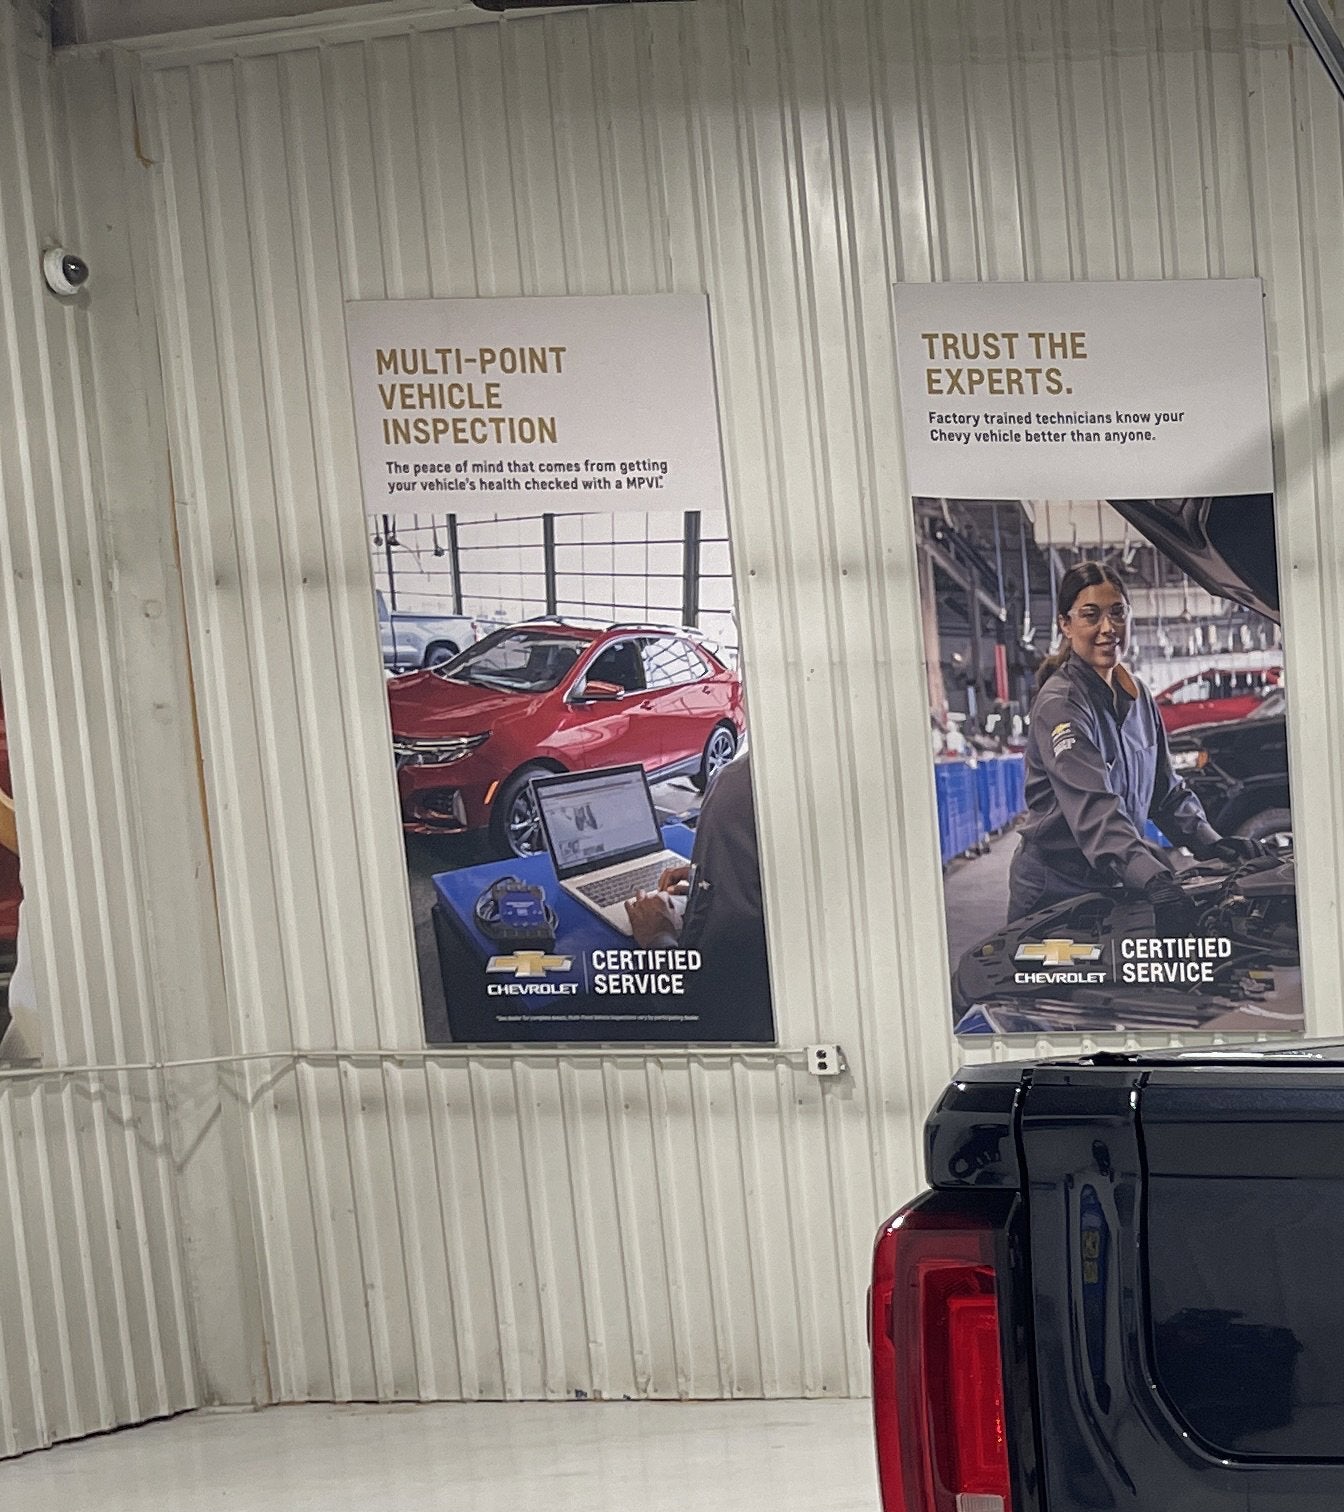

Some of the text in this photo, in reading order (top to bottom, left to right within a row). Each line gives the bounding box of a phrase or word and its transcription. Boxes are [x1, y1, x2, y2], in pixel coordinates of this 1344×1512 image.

[921, 331, 1088, 360] TRUST THE
[376, 346, 566, 375] MULTI-POINT
[926, 367, 1073, 395] EXPERTS.
[378, 382, 503, 410] VEHICLE
[928, 411, 1184, 427] Factory trained technicians know your
[382, 416, 558, 445] INSPECTION
[930, 429, 1156, 444] Chevy vehicle better than anyone.
[386, 459, 669, 476] The peace of mind that comes from getting
[388, 479, 416, 494] your
[420, 477, 476, 491] vehicle's
[479, 477, 521, 490] health
[524, 477, 578, 490] checked
[582, 476, 612, 490] with
[615, 479, 623, 489] a
[1121, 937, 1232, 959] CERTIFIED
[591, 949, 702, 971] CERTIFIED
[1015, 972, 1107, 984] CHEVROLET
[1122, 961, 1214, 983] SERVICE
[487, 982, 579, 996] CHEVROLET
[594, 974, 685, 995] SERVICE
